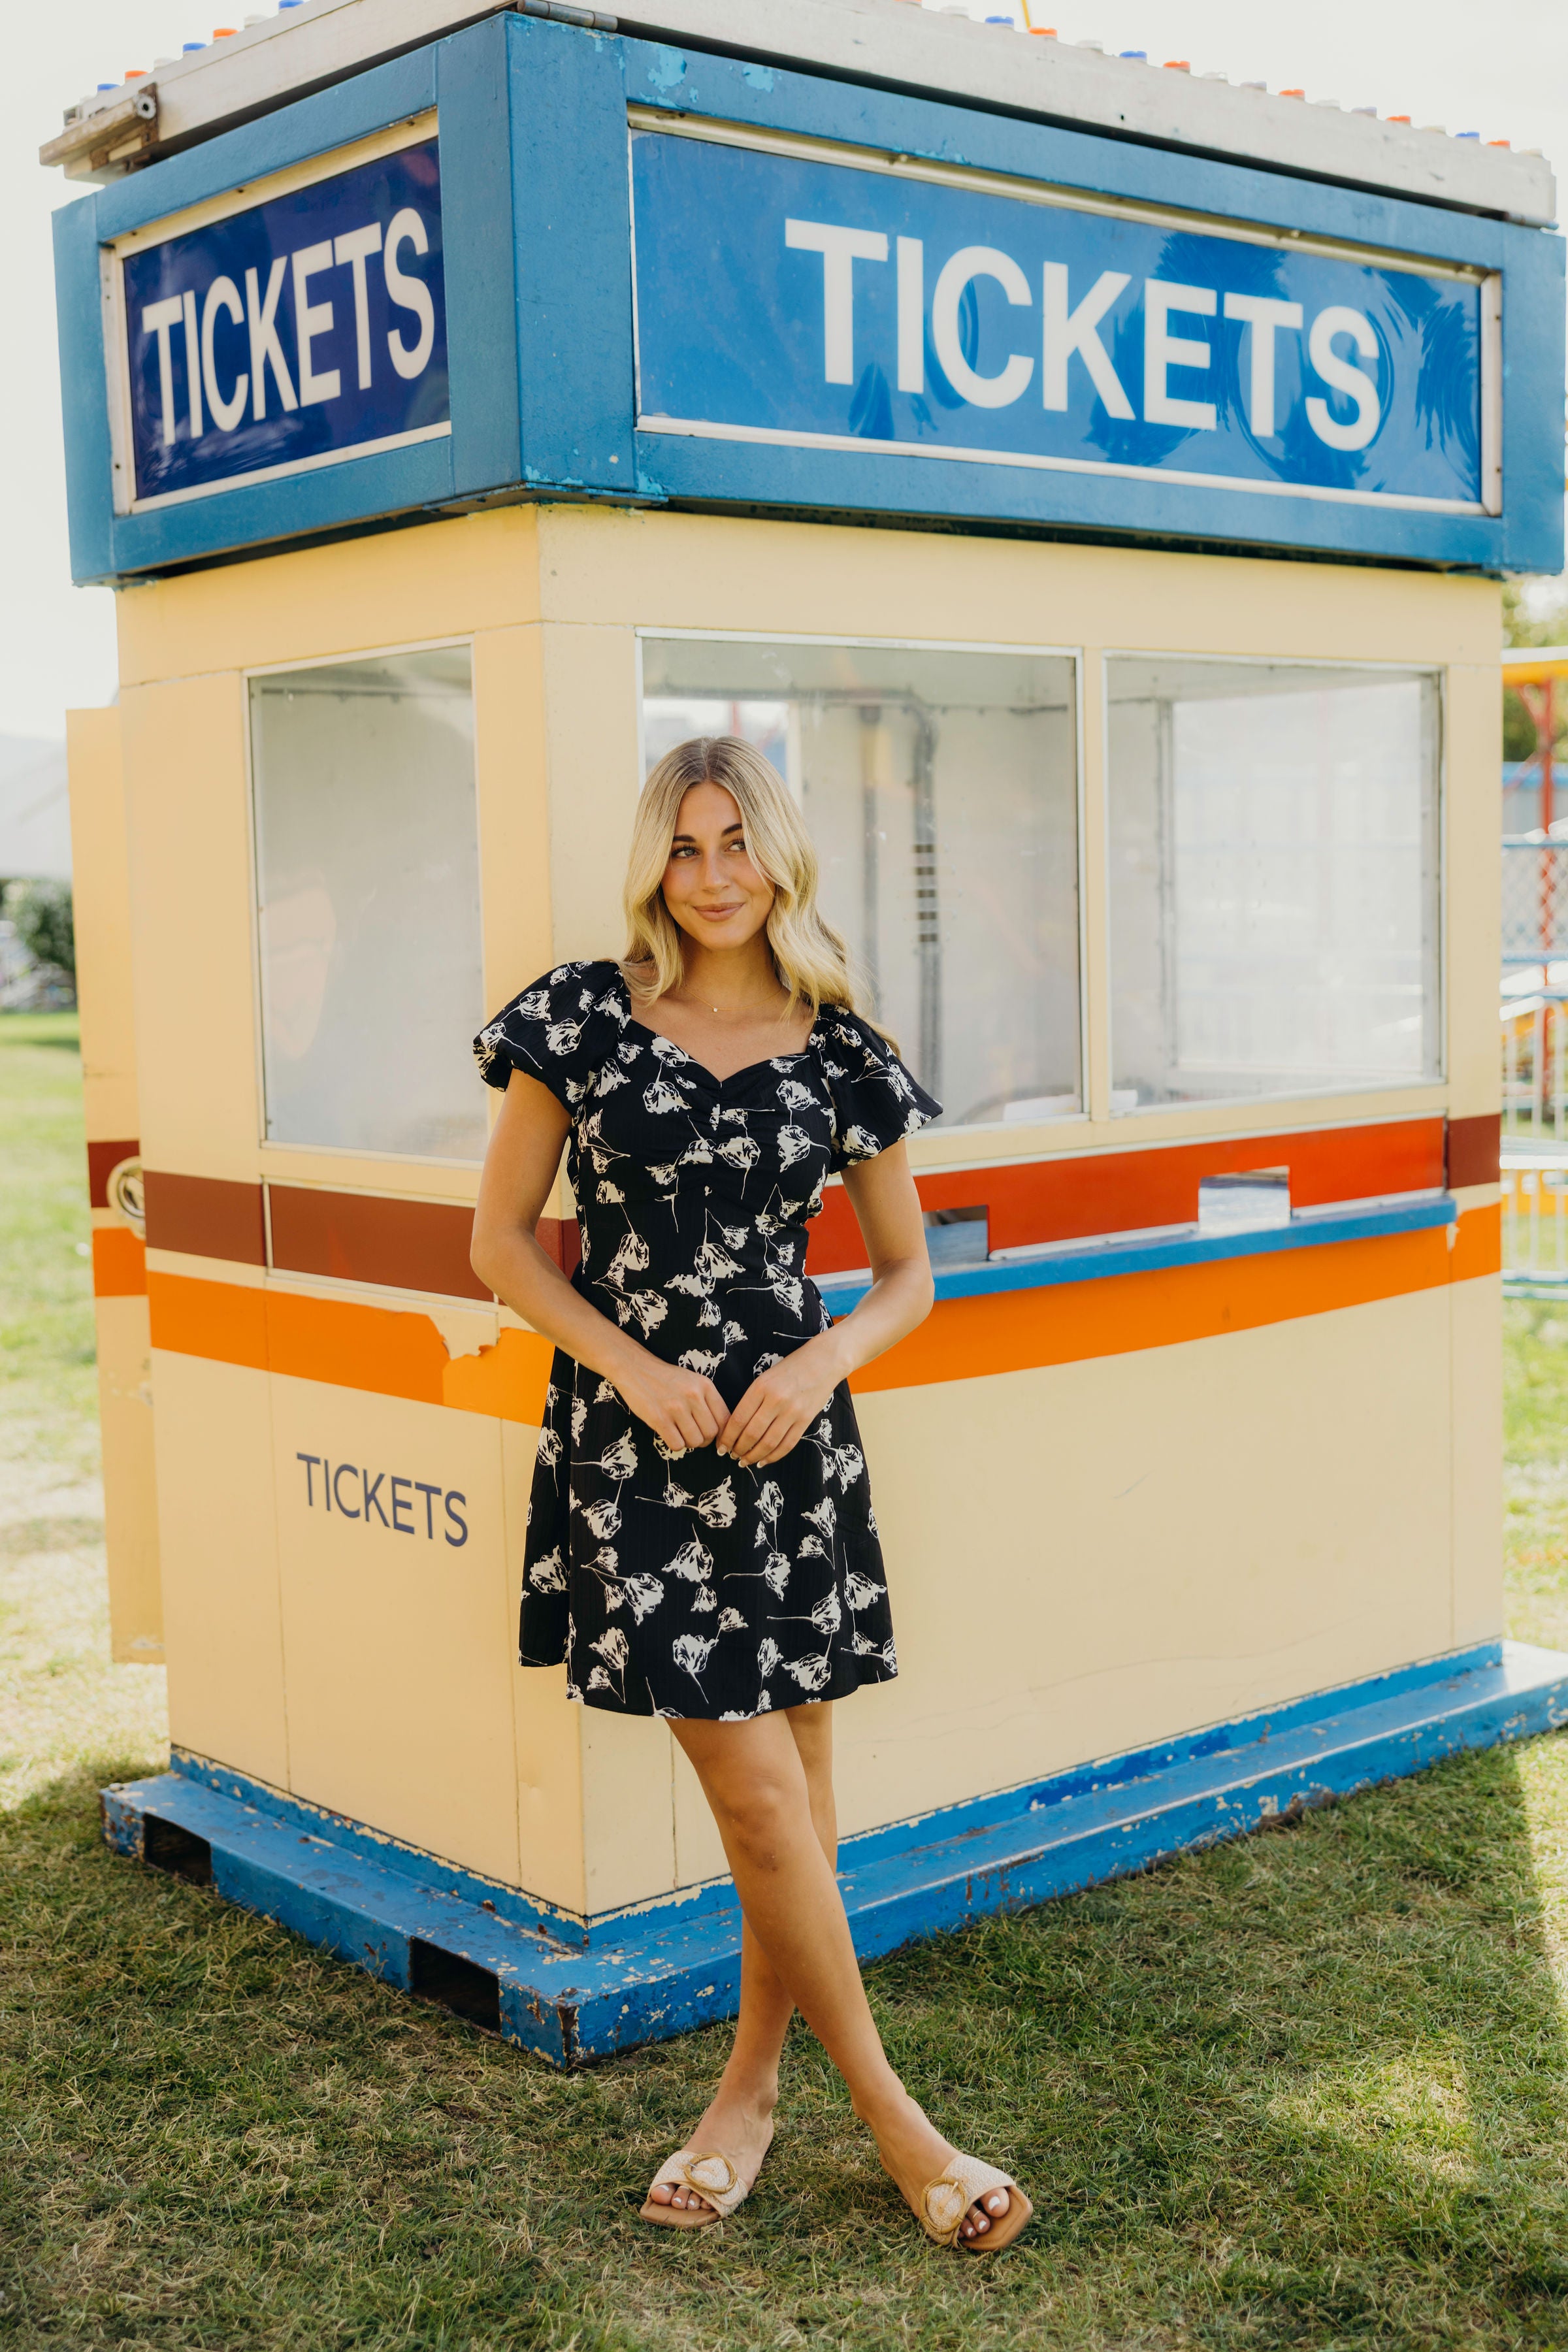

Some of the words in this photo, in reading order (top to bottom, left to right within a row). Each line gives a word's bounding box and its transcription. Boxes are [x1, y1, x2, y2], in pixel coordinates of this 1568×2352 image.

[142, 207, 435, 446] TICKETS
[785, 218, 1380, 451] TICKETS
[297, 1452, 468, 1547] TICKETS
